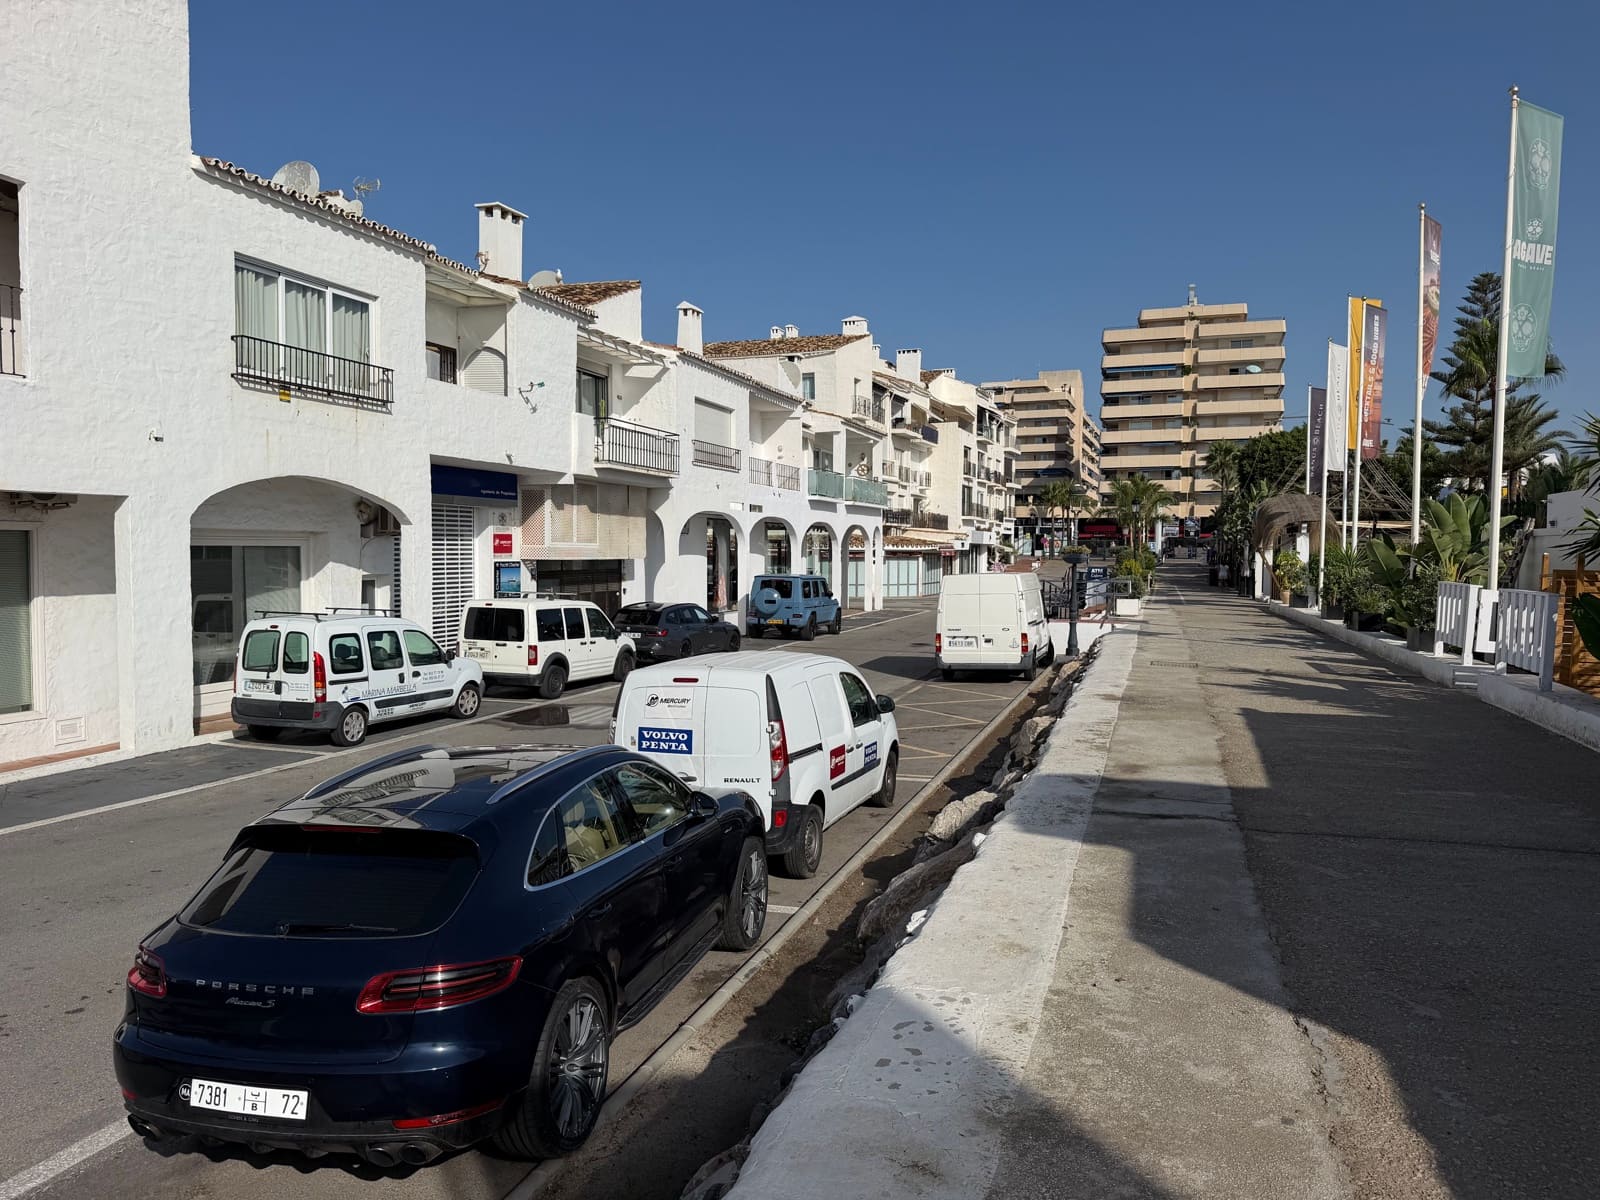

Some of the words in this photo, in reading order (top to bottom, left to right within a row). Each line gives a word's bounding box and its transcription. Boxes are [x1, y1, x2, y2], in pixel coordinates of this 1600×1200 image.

[1513, 240, 1554, 266] AGAVE
[1370, 344, 1378, 366] GOOD
[1314, 403, 1324, 435] BEACH
[362, 687, 386, 698] MARINA
[386, 684, 416, 695] MARBELLA
[641, 730, 688, 741] VOLVO
[641, 740, 689, 751] PENTA
[195, 978, 315, 998] PORSCHE
[225, 996, 262, 1007] Macan
[198, 1084, 227, 1107] 7381
[282, 1094, 300, 1115] 72
[251, 1103, 258, 1111] B
